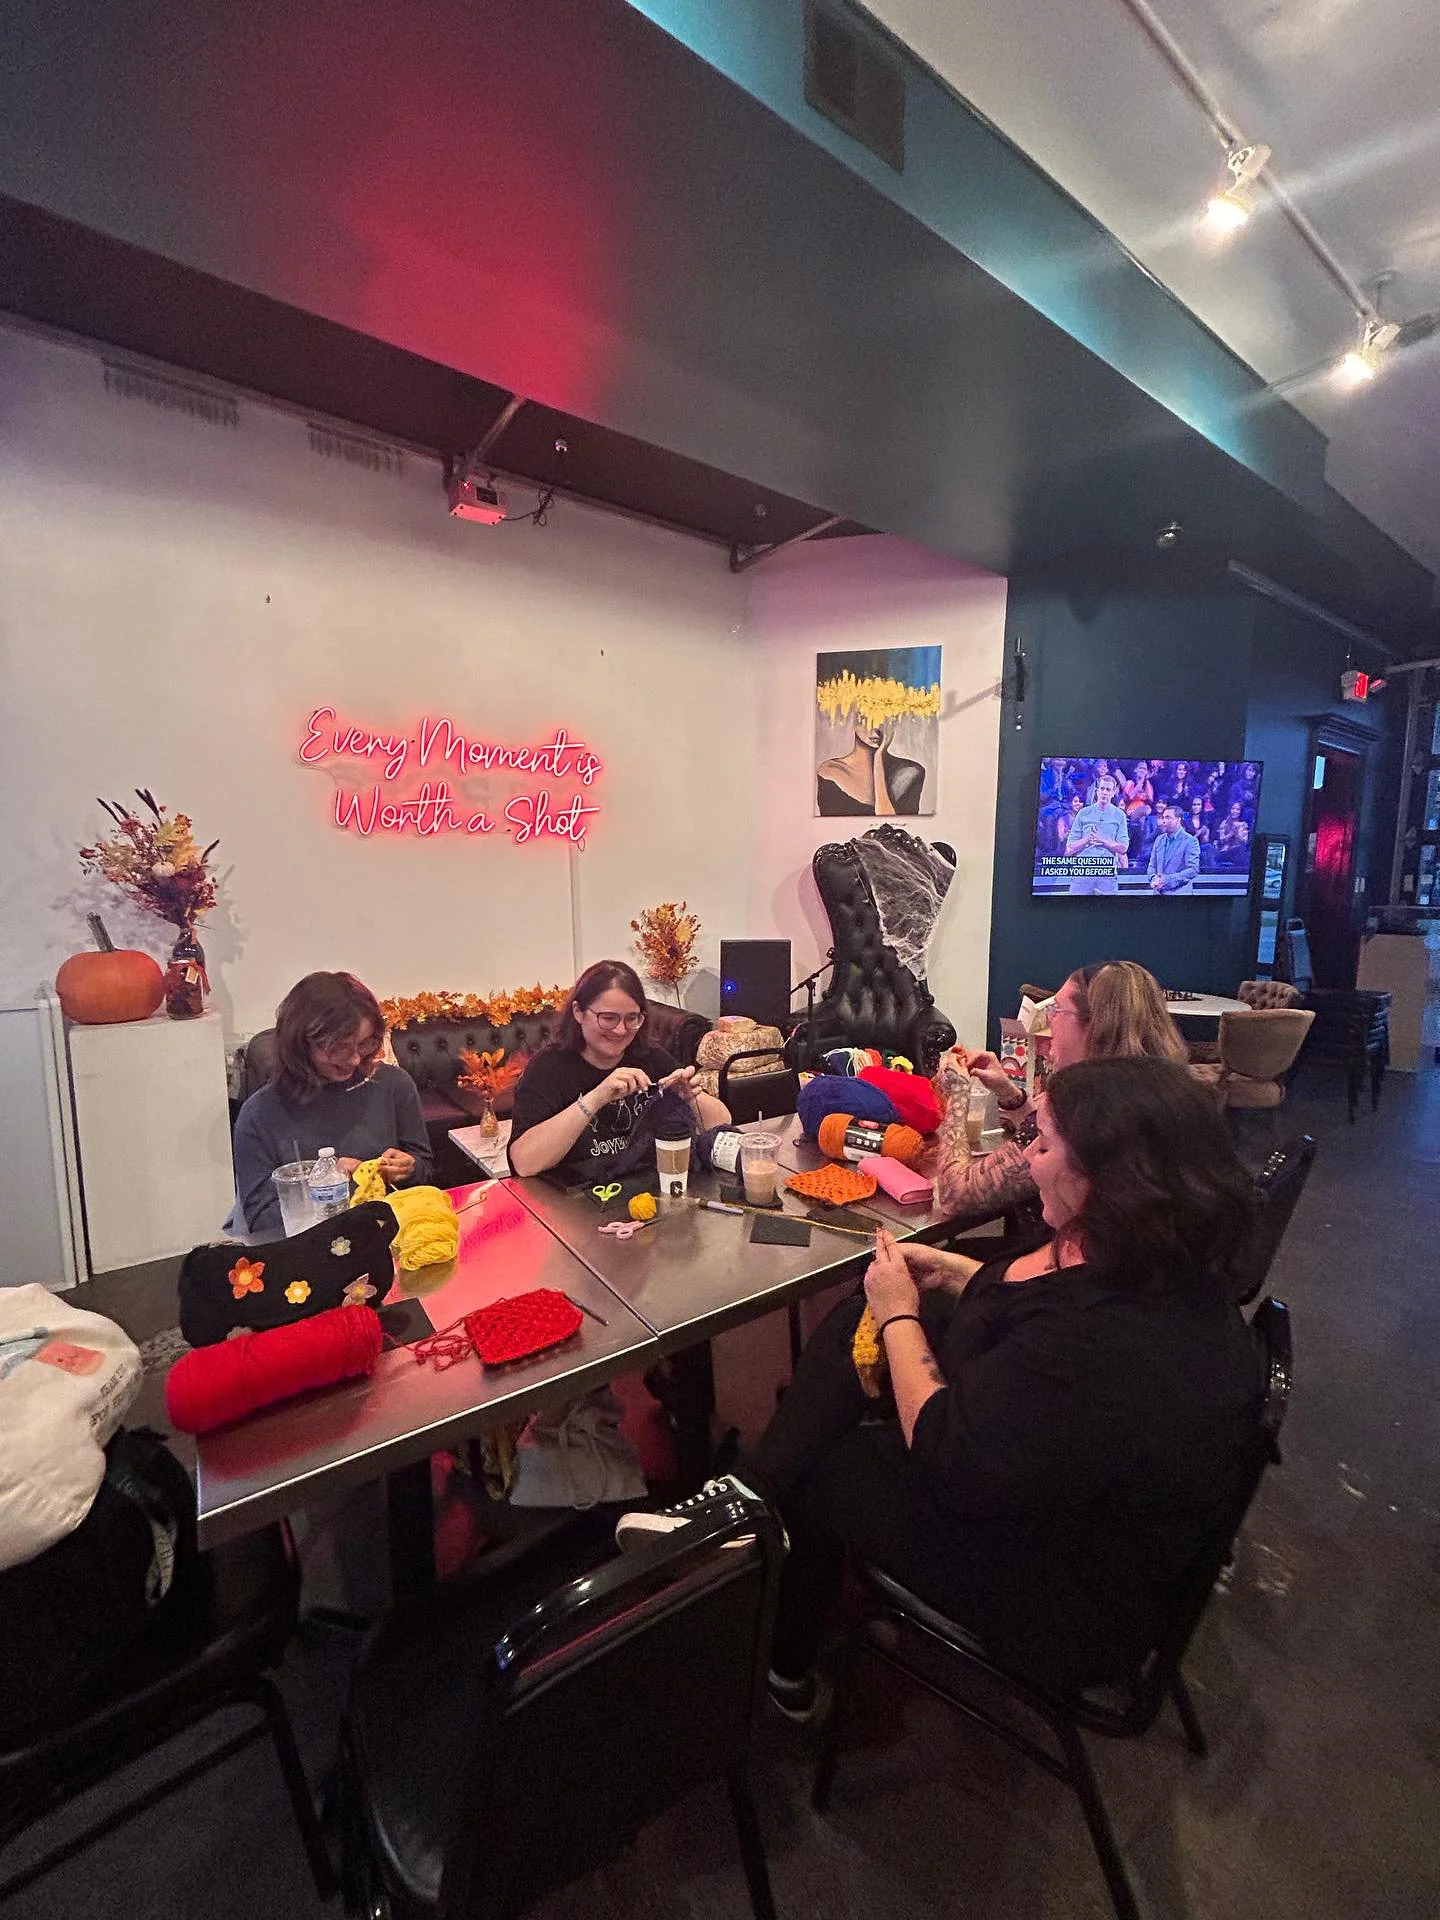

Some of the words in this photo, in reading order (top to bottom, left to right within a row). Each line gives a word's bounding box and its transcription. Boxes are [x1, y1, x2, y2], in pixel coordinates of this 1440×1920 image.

[300, 707, 407, 779] Every
[420, 717, 584, 776] Moment
[577, 752, 602, 784] is
[335, 782, 462, 835] Worth
[467, 810, 495, 832] a
[504, 790, 600, 842] Shot
[1042, 857, 1057, 865] THE
[1057, 857, 1077, 865] SAME
[1078, 857, 1113, 865] QUESTION
[1045, 867, 1068, 875] ASKED
[1069, 867, 1084, 875] YOU
[1085, 867, 1113, 875] BEFORE.
